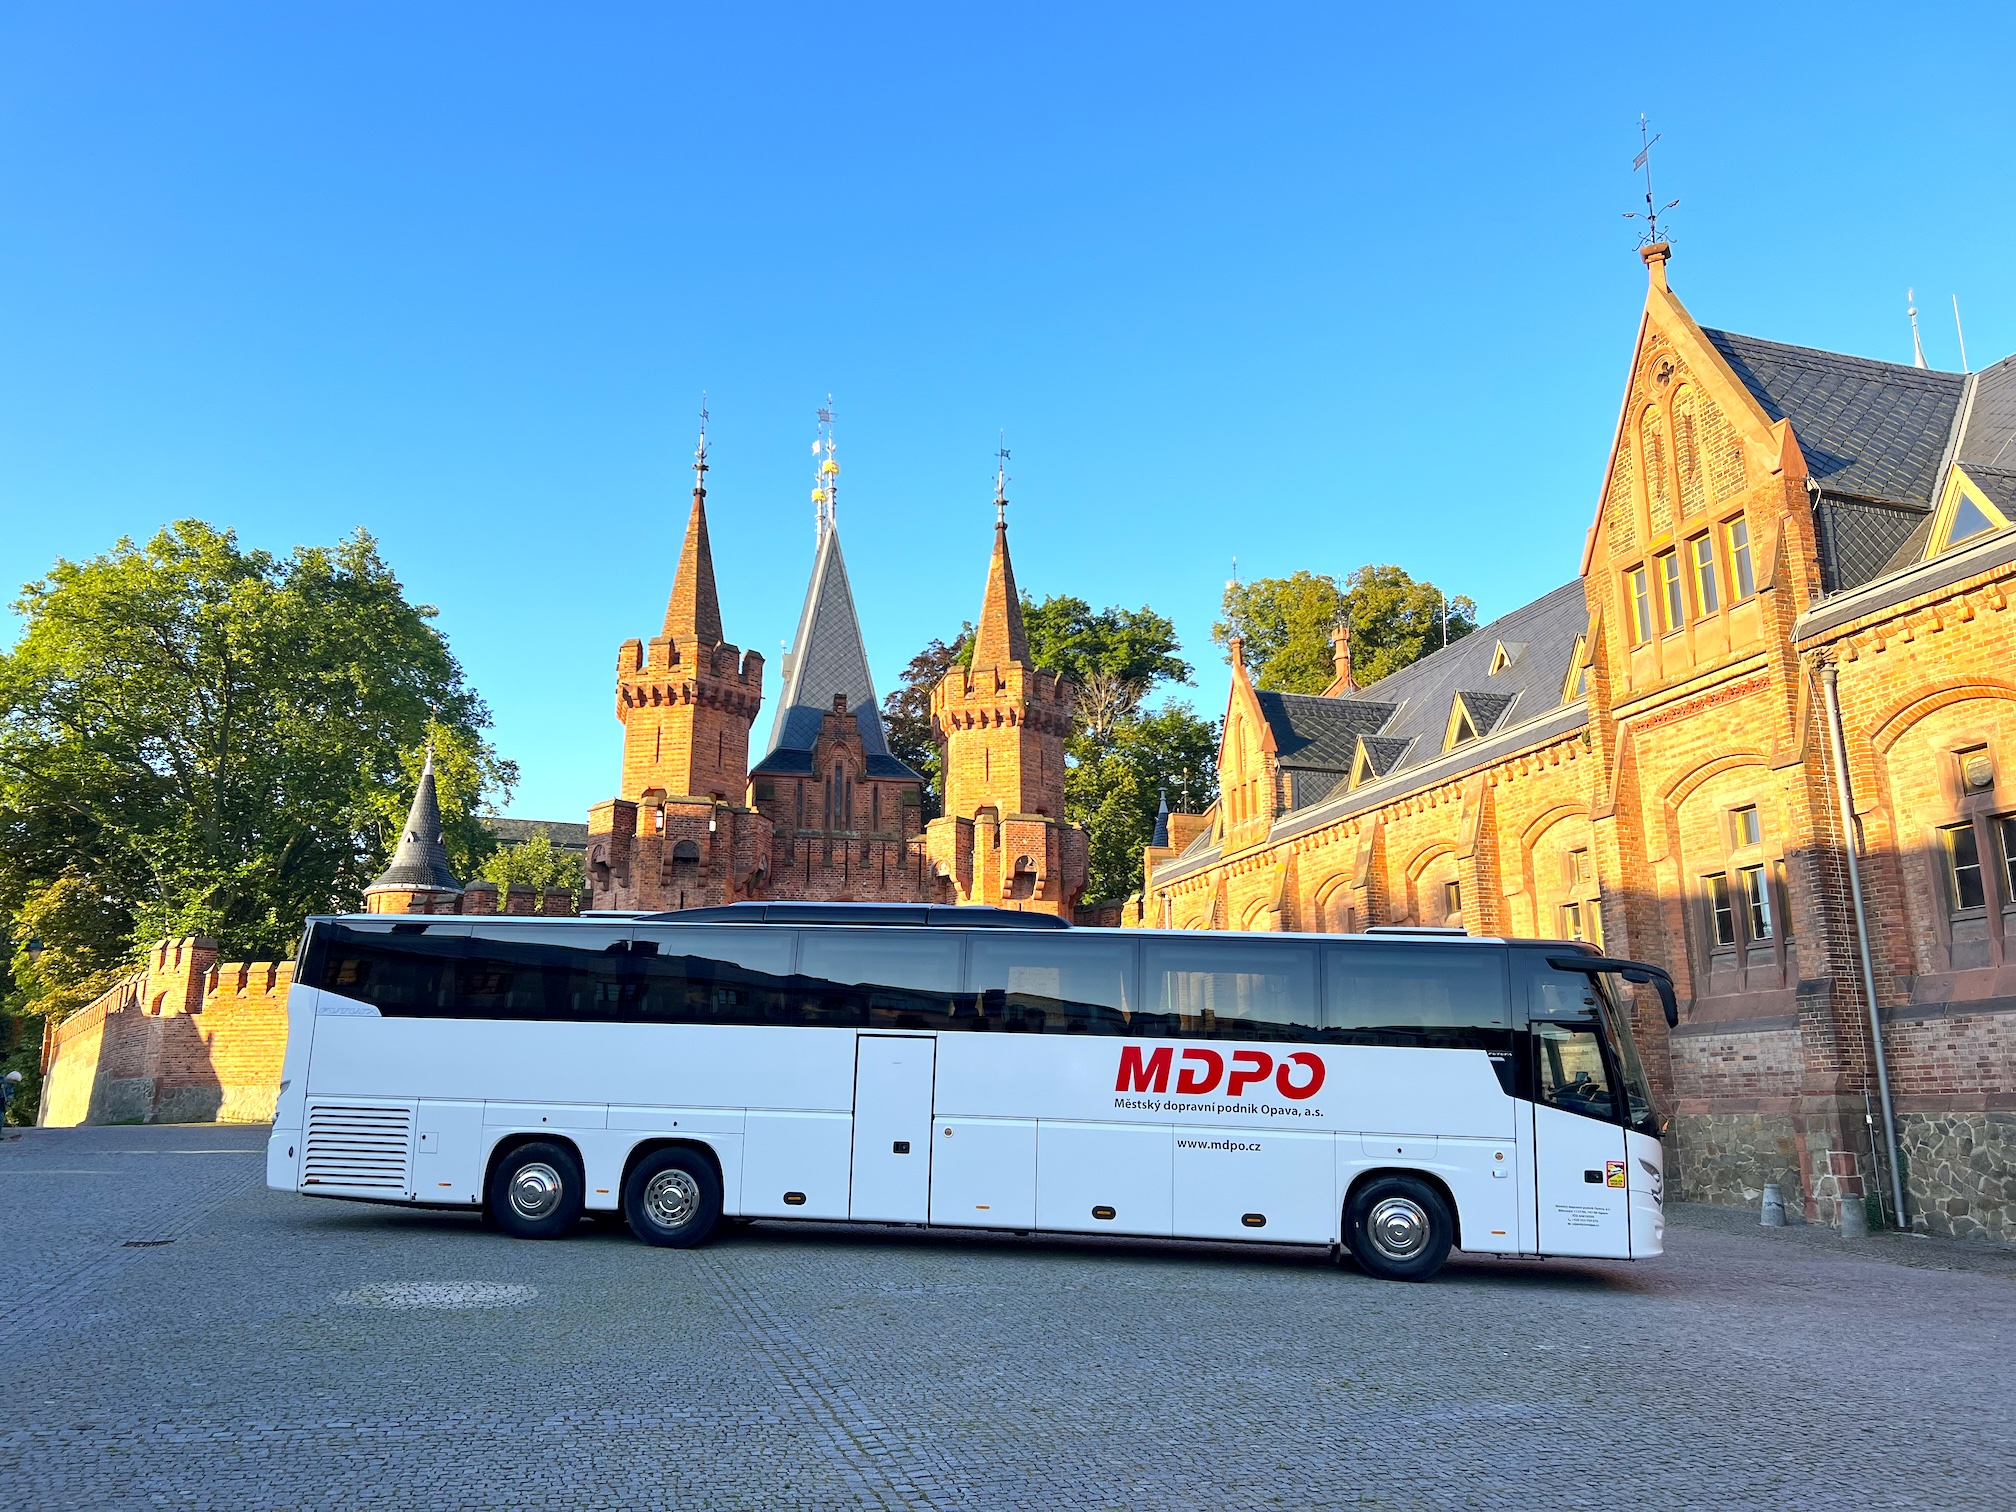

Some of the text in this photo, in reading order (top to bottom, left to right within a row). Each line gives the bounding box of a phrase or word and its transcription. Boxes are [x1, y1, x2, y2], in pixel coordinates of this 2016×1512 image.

[318, 1007, 379, 1015] FUTURA
[1115, 1046, 1326, 1100] MDPO
[1114, 1098, 1324, 1118] Městský dopravní podnik Opava, a.s.
[1177, 1139, 1261, 1153] www.mdpo.cz
